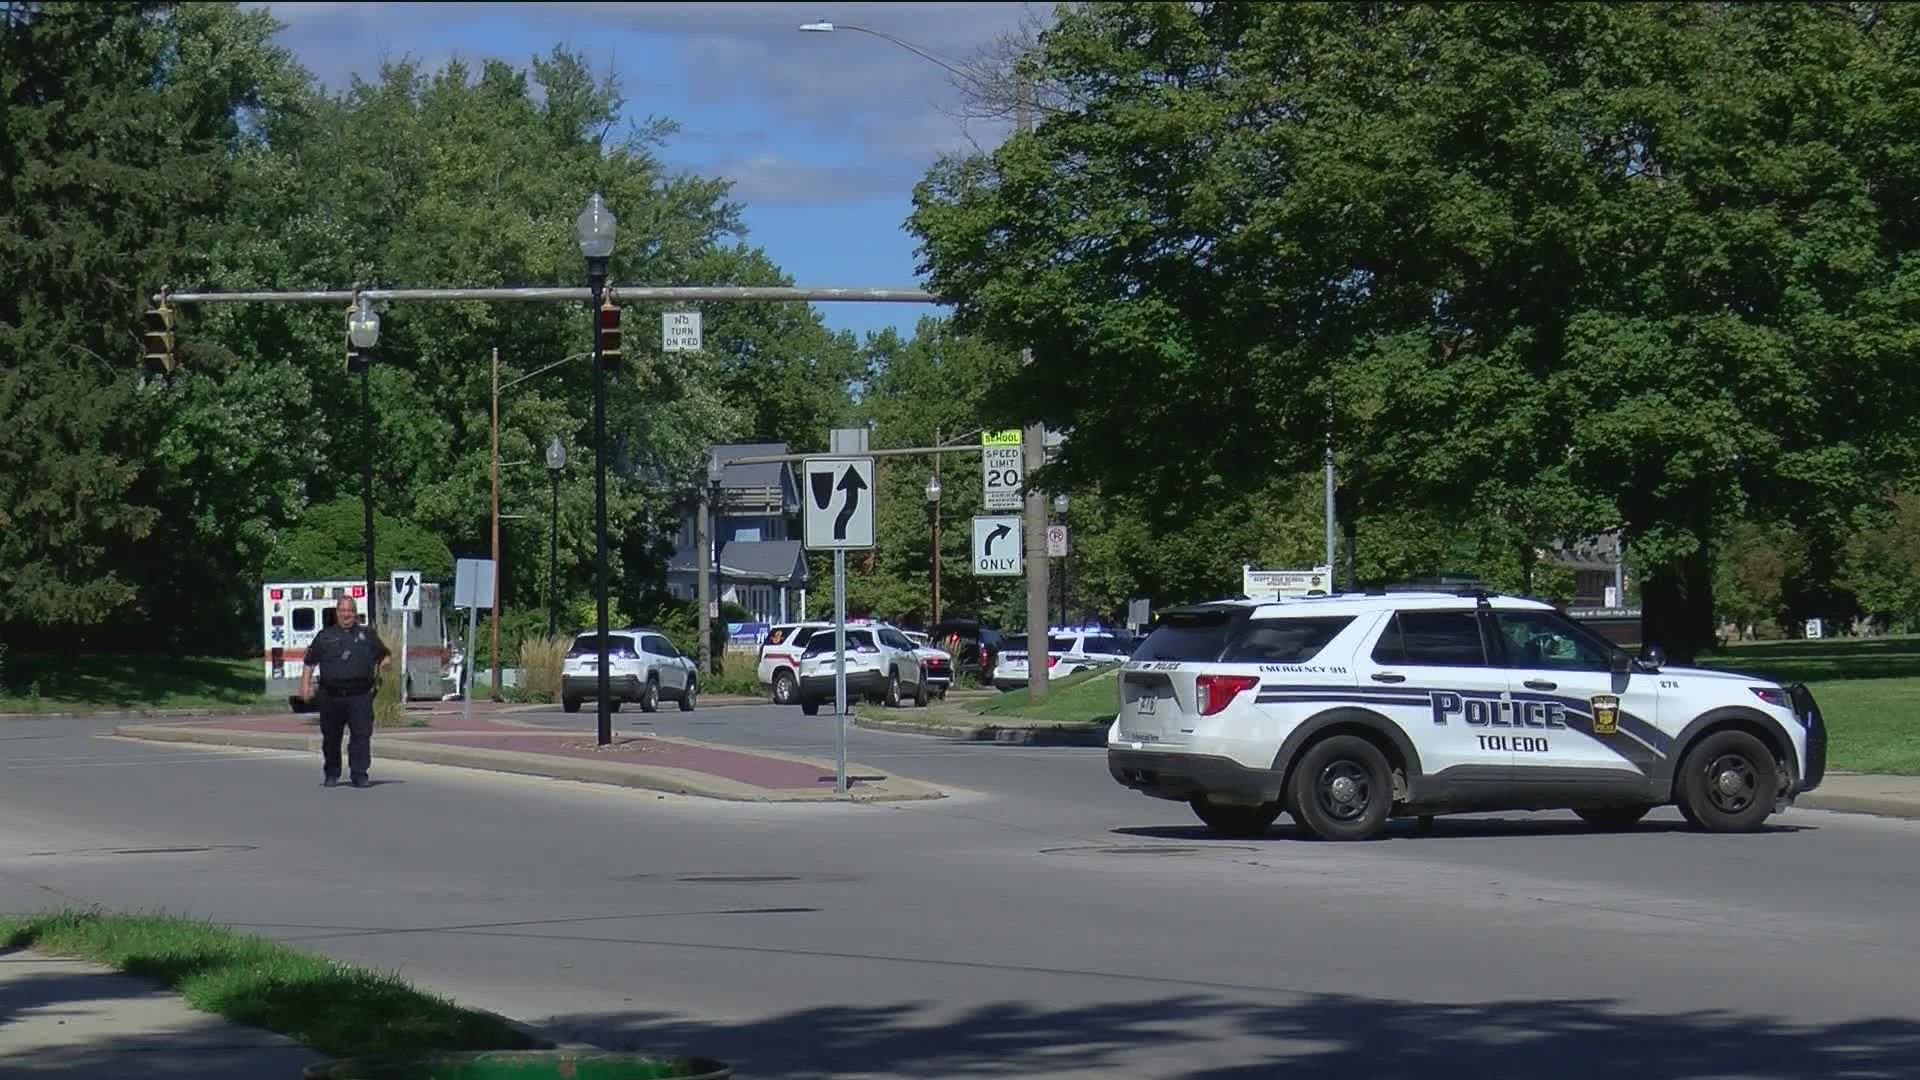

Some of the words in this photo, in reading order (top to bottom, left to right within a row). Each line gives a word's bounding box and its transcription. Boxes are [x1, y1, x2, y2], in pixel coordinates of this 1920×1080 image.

[675, 315, 688, 324] NO
[672, 327, 693, 335] TURN
[986, 449, 1018, 458] SPEED
[990, 459, 1014, 468] LIMIT
[988, 469, 1018, 487] 20
[980, 559, 1015, 570] ONLY
[1259, 665, 1326, 673] EMERGENCY
[1429, 690, 1568, 730] POLICE
[1477, 735, 1549, 752] TOLEDO
